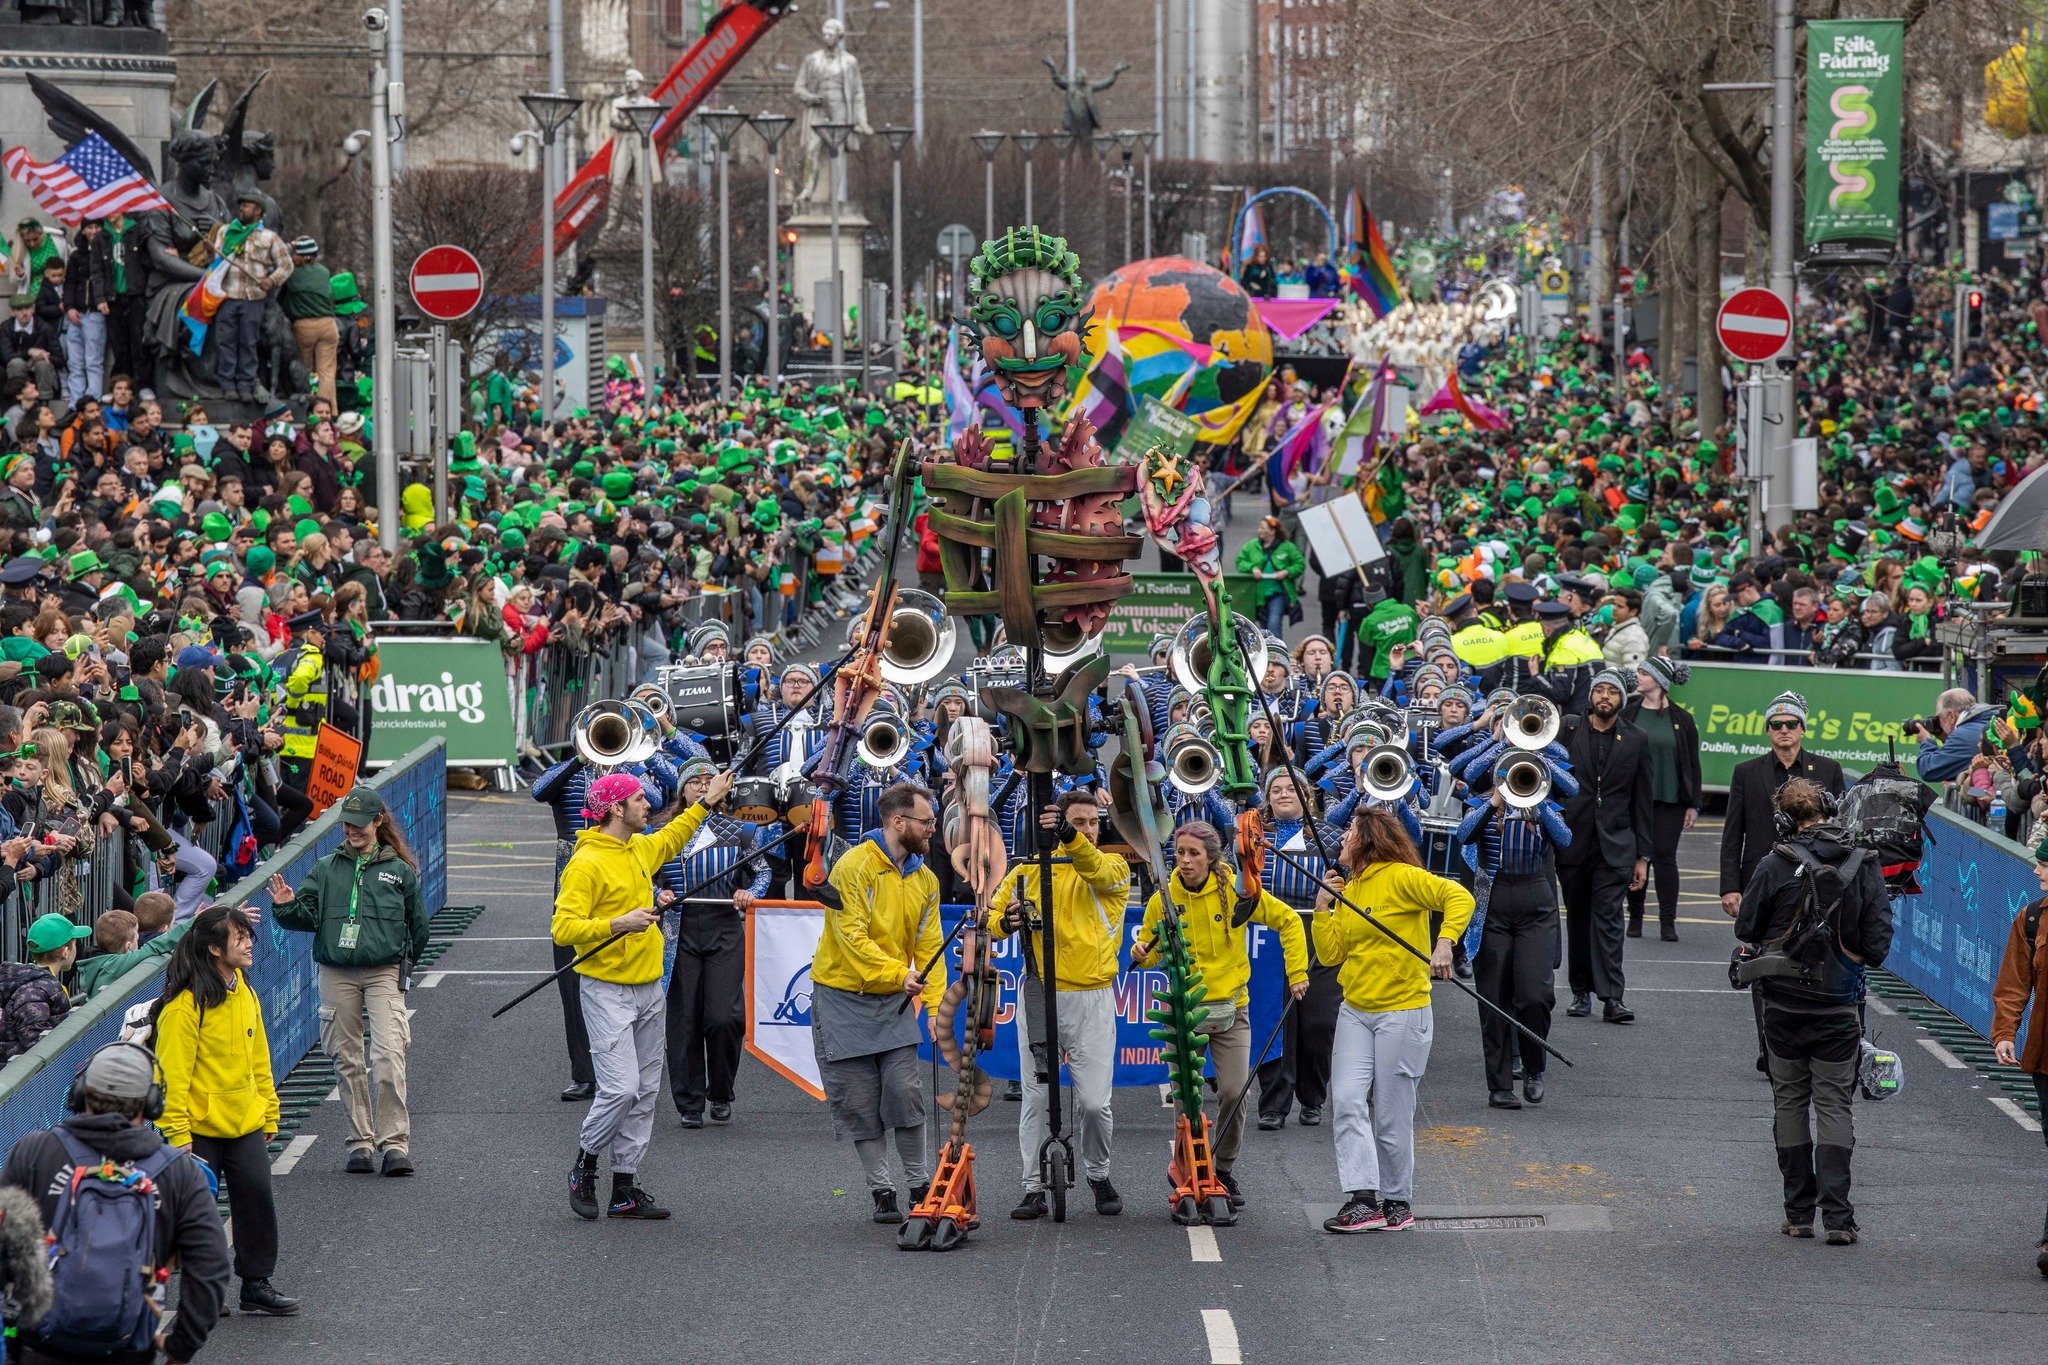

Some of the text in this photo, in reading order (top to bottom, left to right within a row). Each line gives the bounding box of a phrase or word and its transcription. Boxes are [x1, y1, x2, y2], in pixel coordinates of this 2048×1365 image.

[1834, 35, 1875, 53] Féile
[1818, 51, 1890, 72] Pádraig
[1147, 584, 1190, 594] Festival
[1462, 637, 1494, 646] GARDA
[1521, 632, 1544, 642] GARD
[371, 671, 485, 724] draig
[684, 686, 712, 696] TAMA
[1701, 741, 1738, 755] Dublin,
[1741, 744, 1772, 755] Irelan
[319, 764, 345, 789] ROAD
[310, 784, 337, 807] CLOS
[1247, 925, 1268, 958] F
[1120, 1047, 1167, 1065] INDIA
